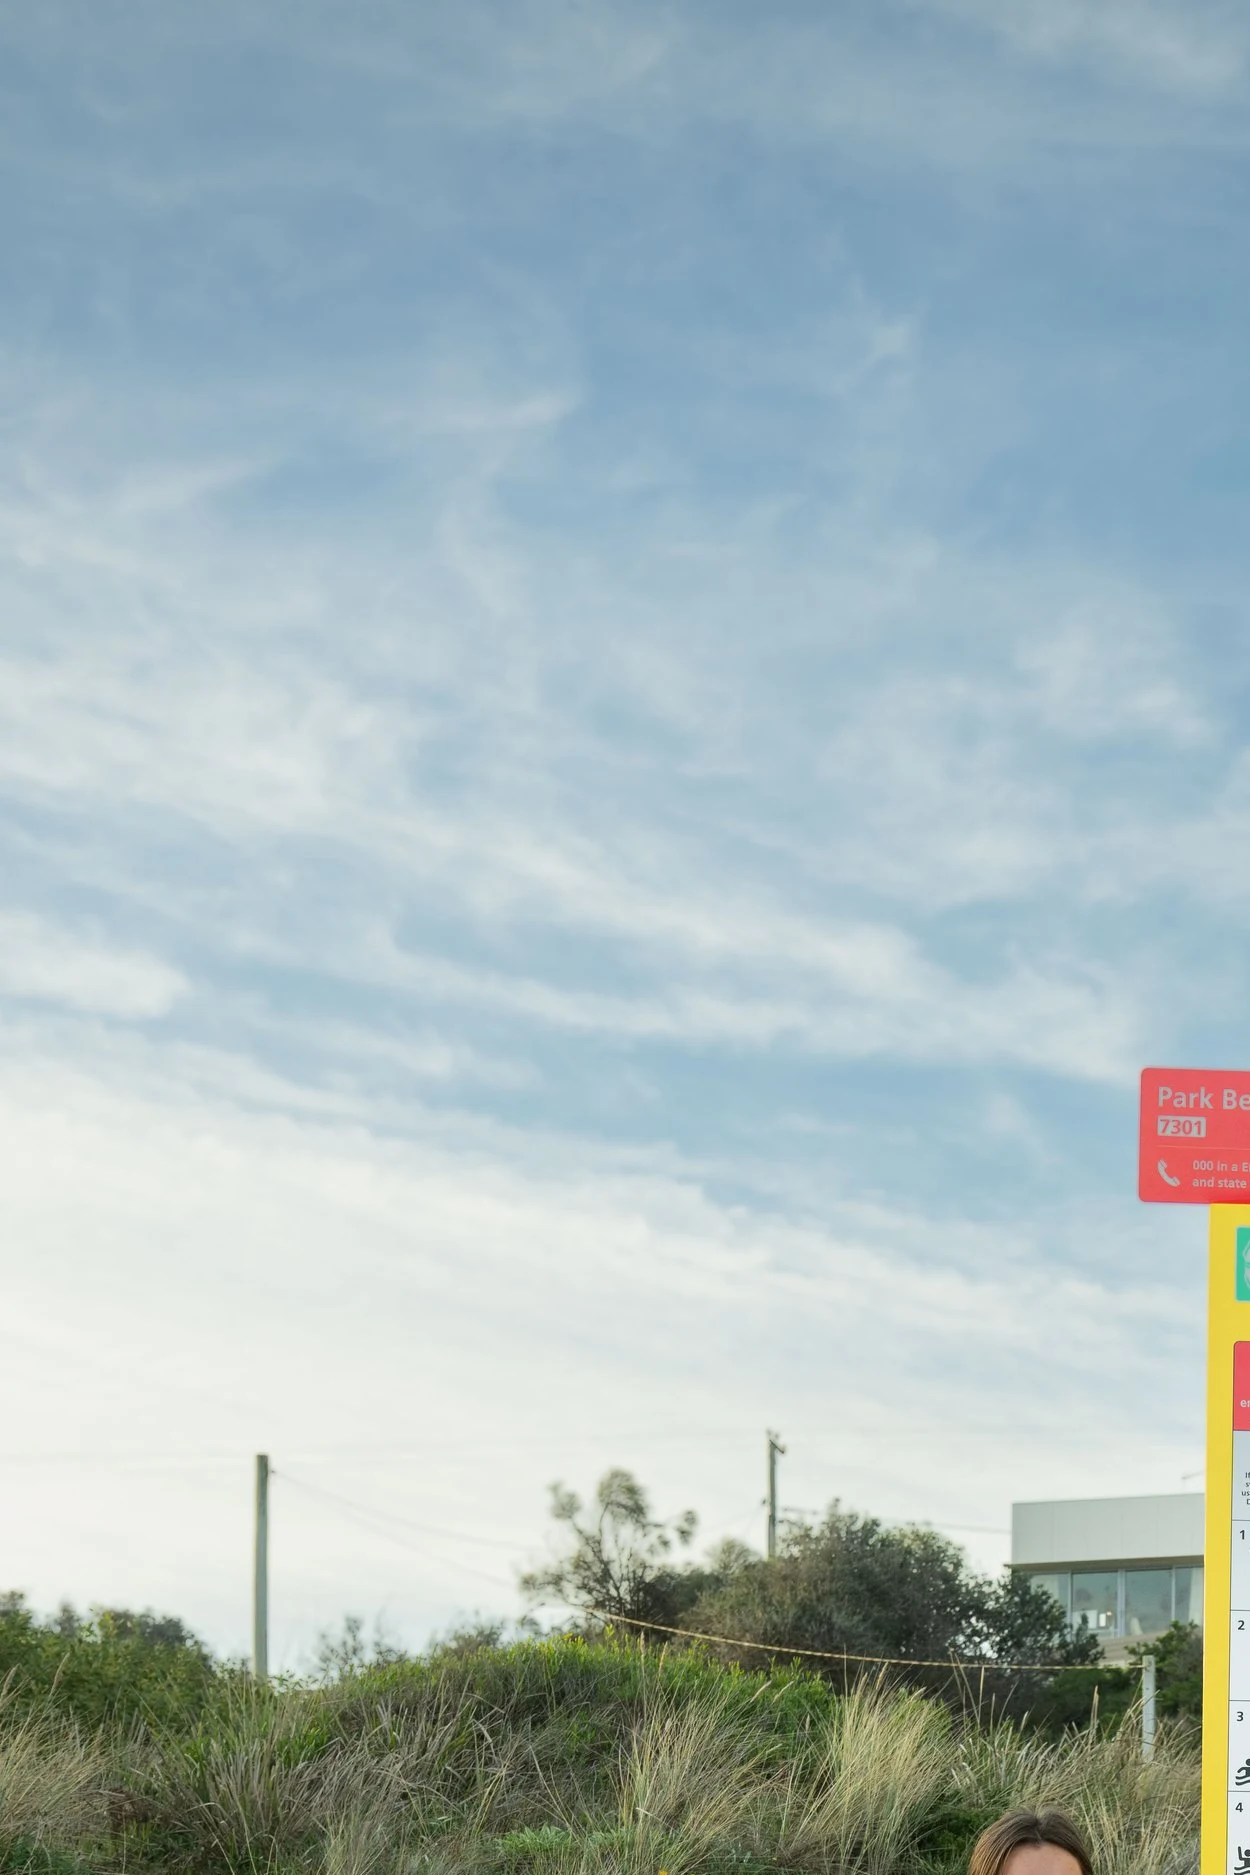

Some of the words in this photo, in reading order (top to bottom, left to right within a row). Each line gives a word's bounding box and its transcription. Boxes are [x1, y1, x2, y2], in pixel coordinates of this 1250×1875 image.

[1158, 1086, 1213, 1110] Park
[1159, 1118, 1203, 1136] 7301
[1193, 1160, 1214, 1171] 000
[1231, 1163, 1239, 1172] a
[1192, 1176, 1215, 1188] and
[1218, 1178, 1247, 1189] state
[1240, 1529, 1245, 1540] 1
[1237, 1620, 1245, 1631] 2
[1236, 1711, 1244, 1722] 3
[1235, 1802, 1244, 1813] 4
